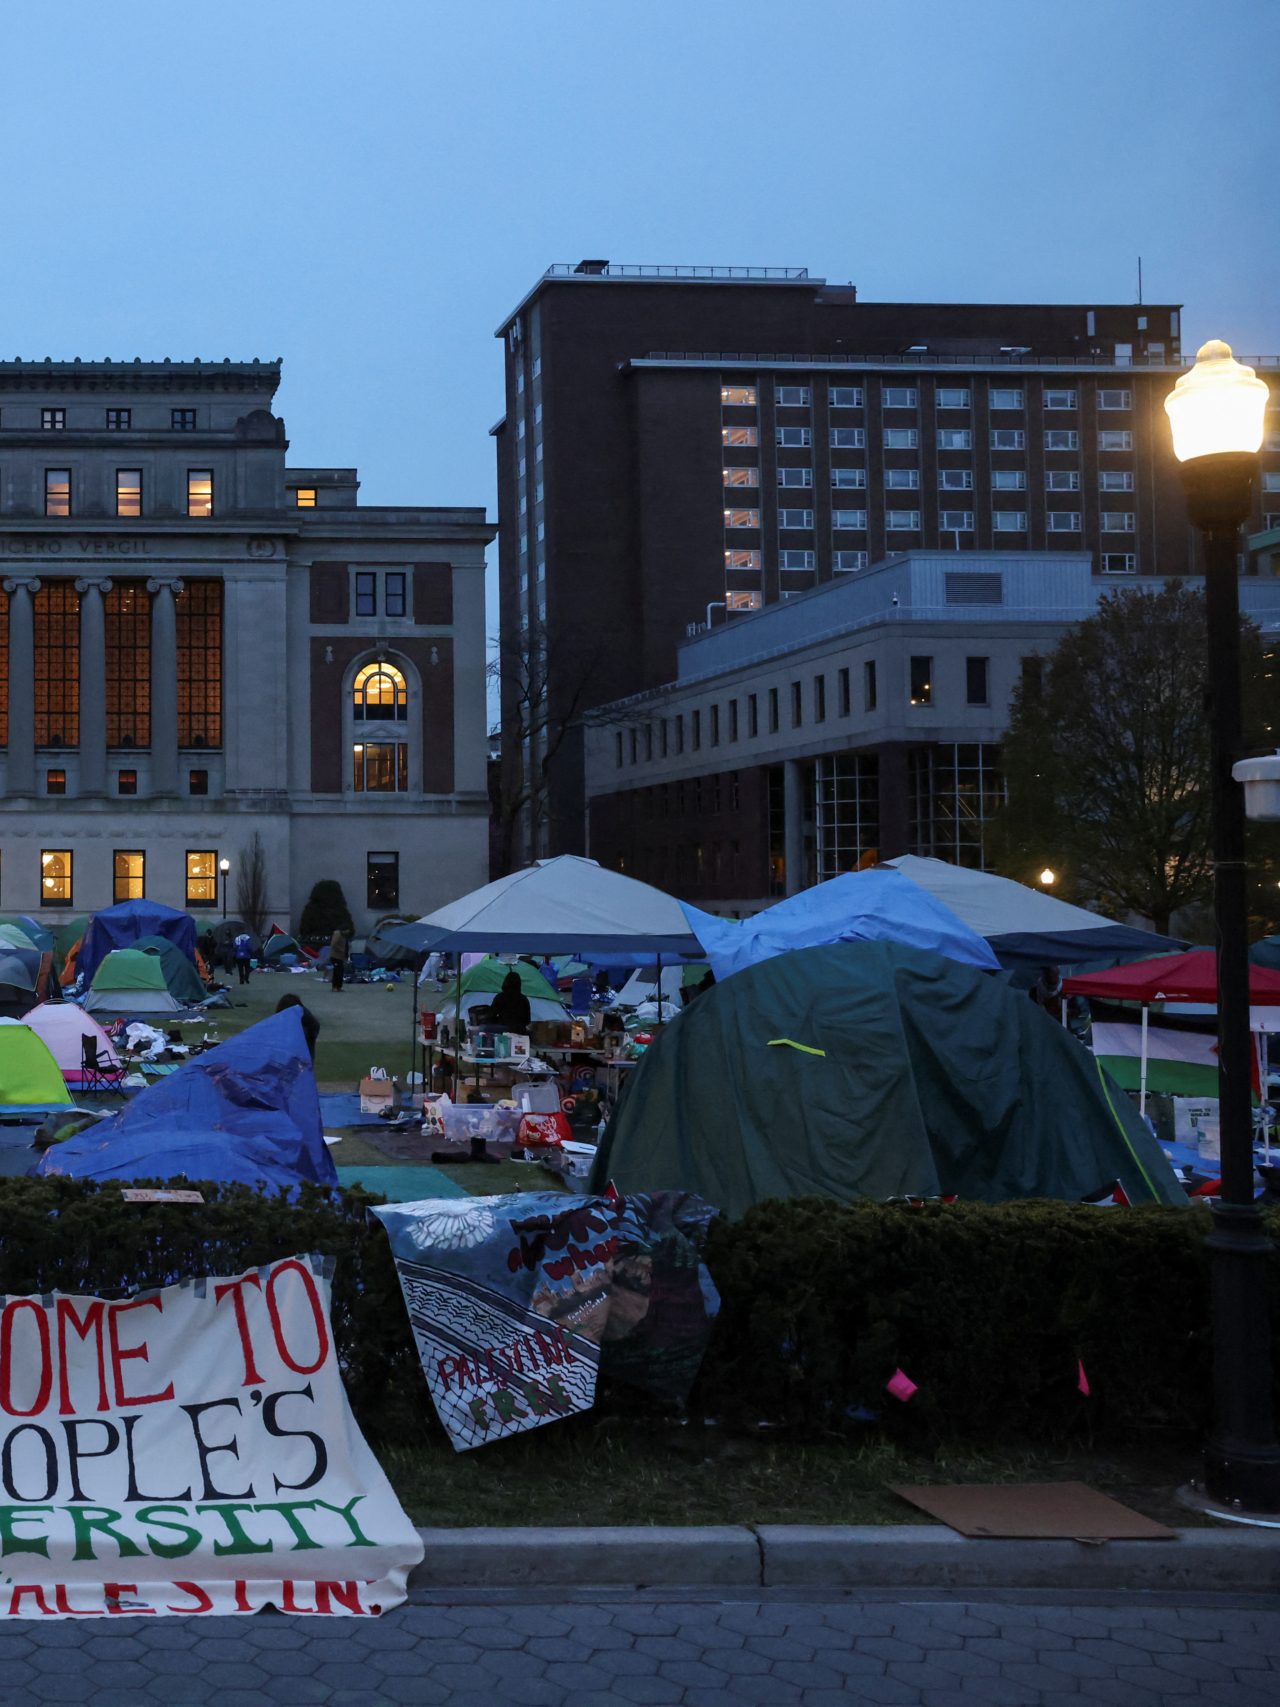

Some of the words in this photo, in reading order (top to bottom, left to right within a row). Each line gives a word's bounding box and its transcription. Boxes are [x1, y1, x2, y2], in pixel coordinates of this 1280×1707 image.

[78, 539, 151, 554] VERGIL
[215, 1259, 330, 1387] TO
[437, 1325, 577, 1392] PALESTINE
[468, 1374, 573, 1431] FREE
